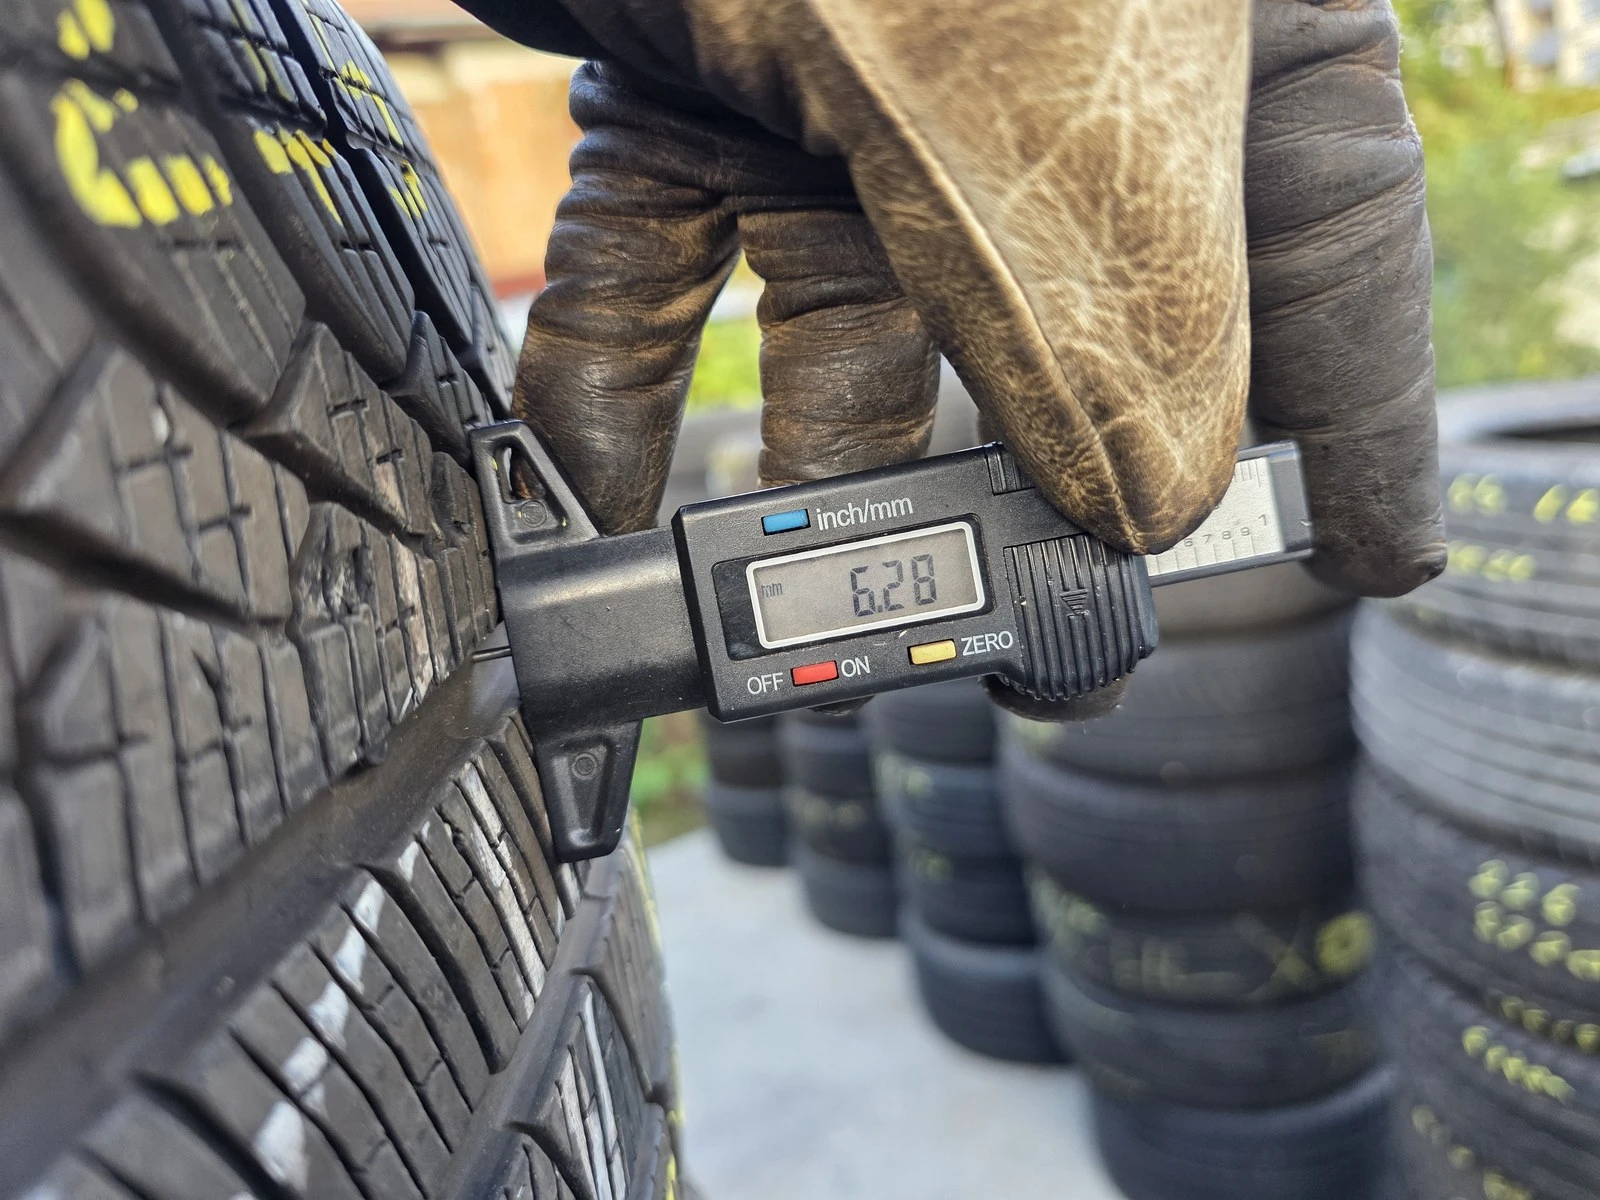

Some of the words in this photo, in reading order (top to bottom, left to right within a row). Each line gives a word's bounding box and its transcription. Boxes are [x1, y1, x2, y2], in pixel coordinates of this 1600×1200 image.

[816, 497, 913, 531] inch/mm
[760, 582, 784, 599] mm
[850, 553, 937, 617] 6.28
[960, 630, 1014, 656] ZERO
[747, 672, 784, 695] OFF
[841, 655, 871, 678] ON
